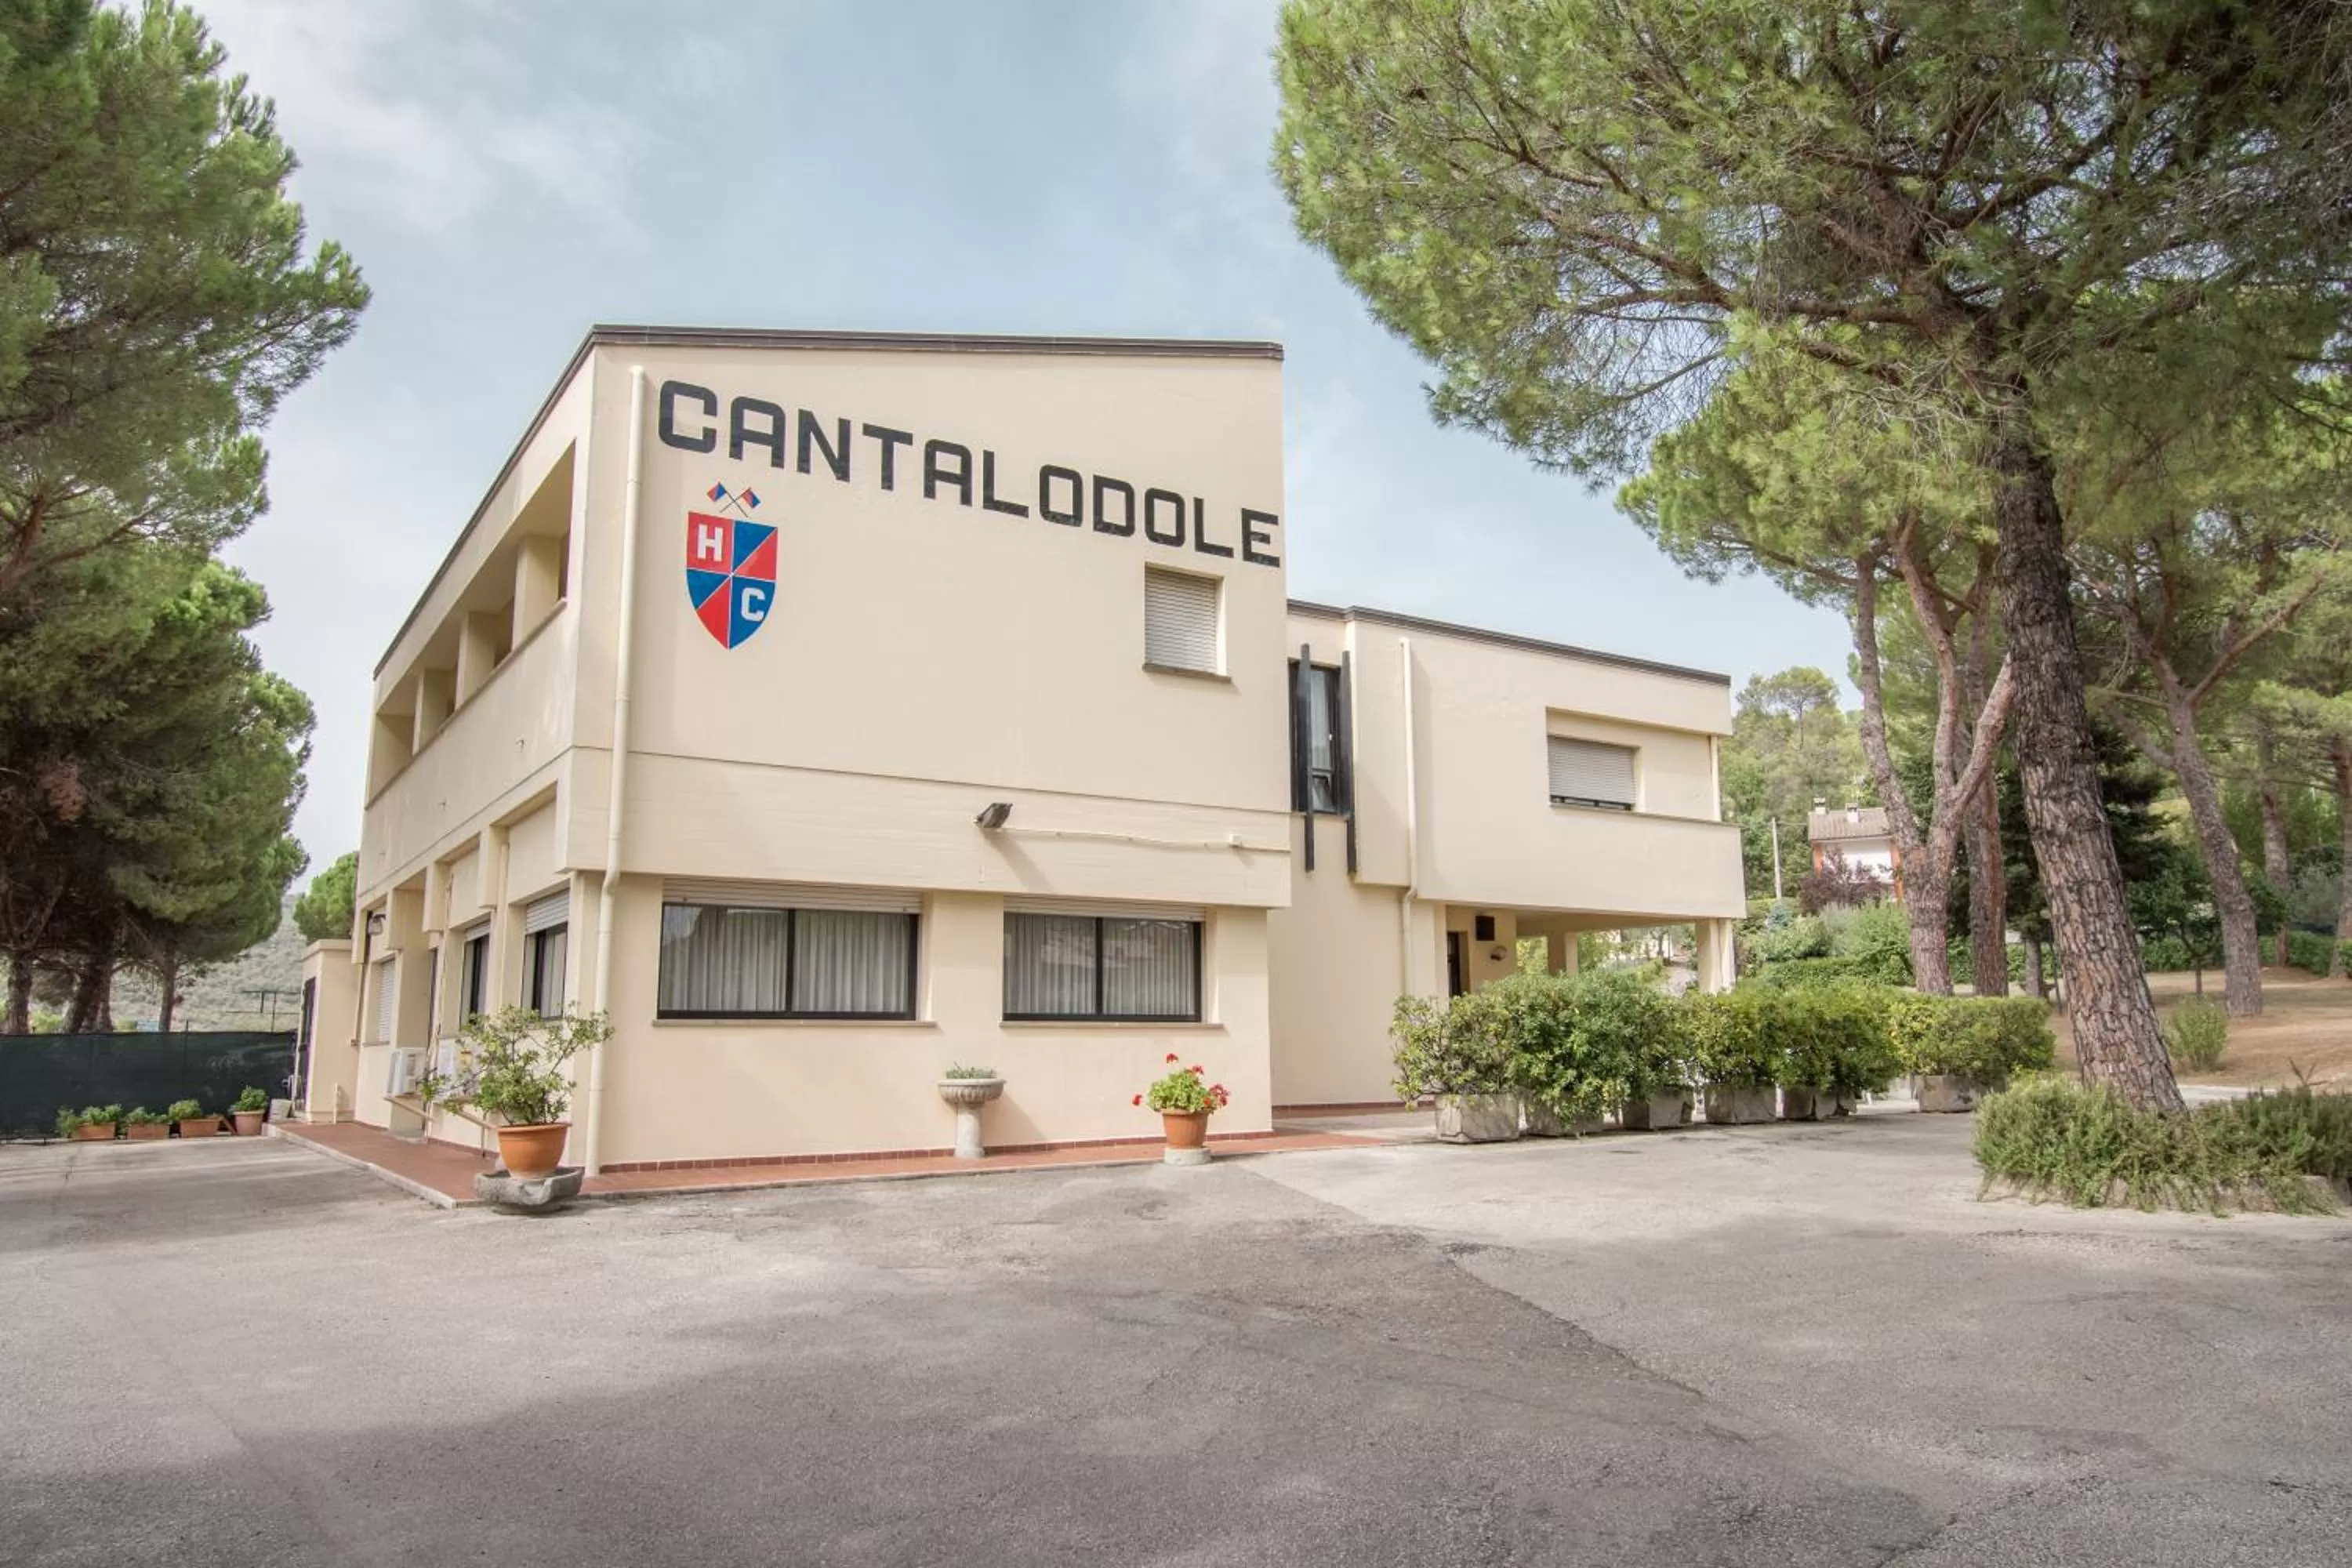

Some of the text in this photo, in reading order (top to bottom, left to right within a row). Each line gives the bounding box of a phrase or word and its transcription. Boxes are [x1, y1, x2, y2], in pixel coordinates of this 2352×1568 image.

[659, 379, 1280, 568] CANTALODOLE
[697, 523, 724, 562] H
[741, 587, 766, 622] C
